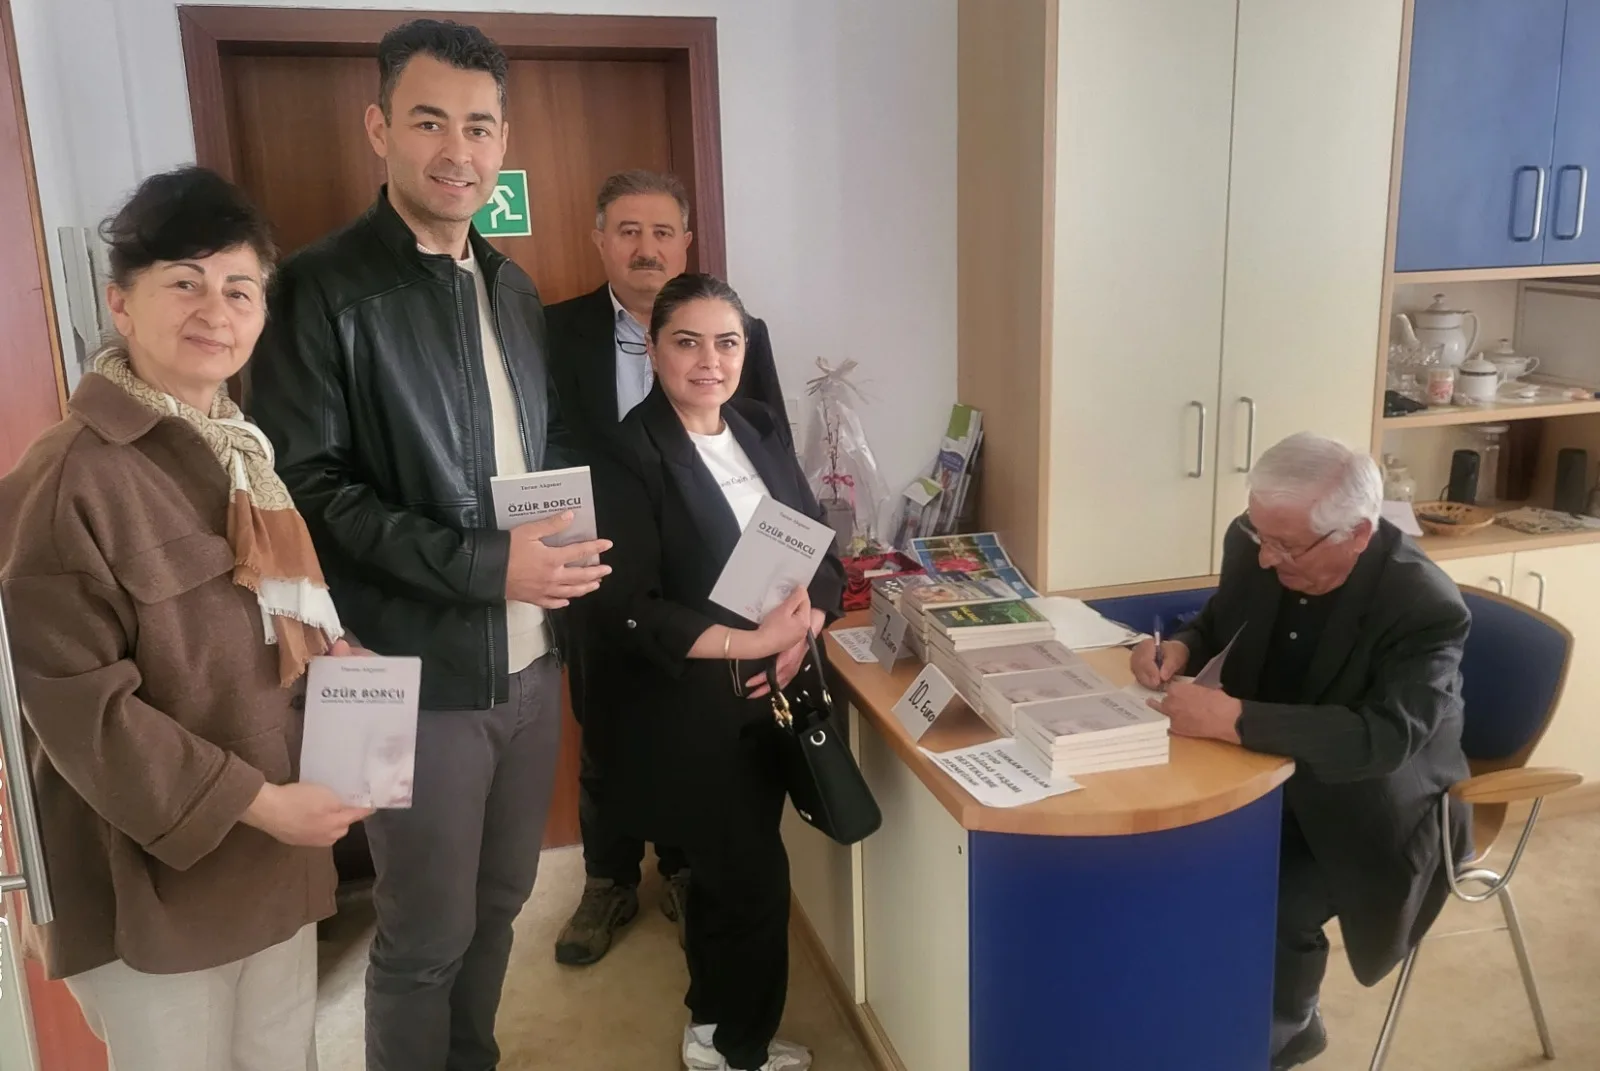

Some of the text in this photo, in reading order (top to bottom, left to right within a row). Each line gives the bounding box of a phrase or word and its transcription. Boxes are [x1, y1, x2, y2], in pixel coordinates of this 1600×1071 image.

[507, 501, 540, 513] ÖZÜR
[543, 497, 582, 509] BORCU
[758, 520, 784, 539] ÖZÜR
[784, 535, 816, 555] BORCU
[321, 685, 405, 699] ÖZÜR BORCU
[920, 699, 936, 722] Euro
[954, 755, 999, 789] DESTEKLEME
